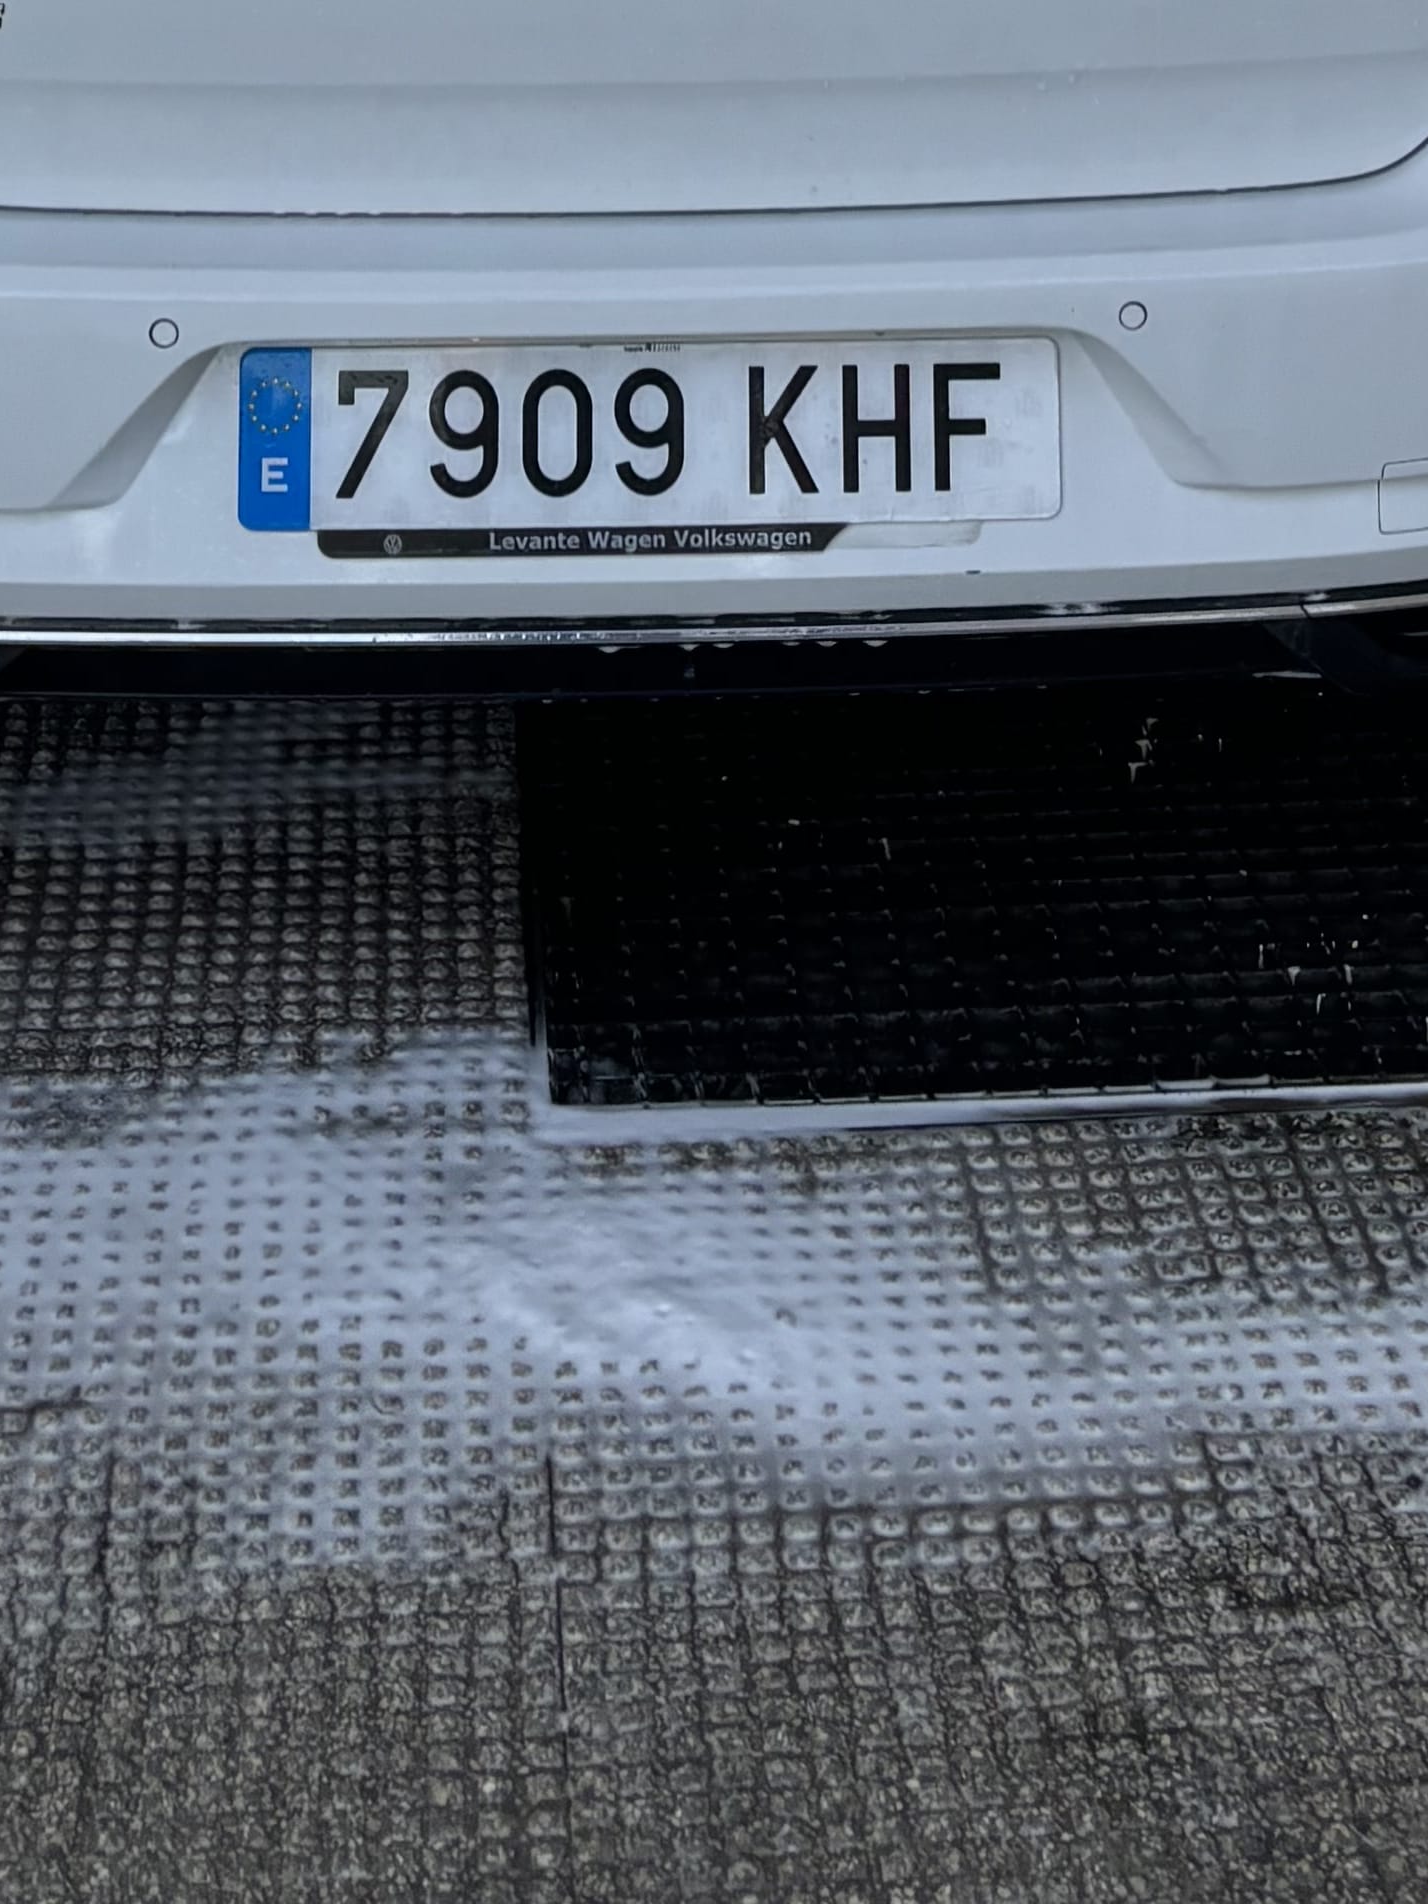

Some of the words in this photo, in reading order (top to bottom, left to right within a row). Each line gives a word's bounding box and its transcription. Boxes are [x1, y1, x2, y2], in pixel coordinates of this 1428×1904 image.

[335, 362, 686, 500] 7909
[747, 362, 1002, 496] KHF
[260, 457, 289, 493] E
[488, 530, 580, 553] Levante
[587, 530, 667, 553] Wagen
[673, 527, 813, 550] Volkswagen
